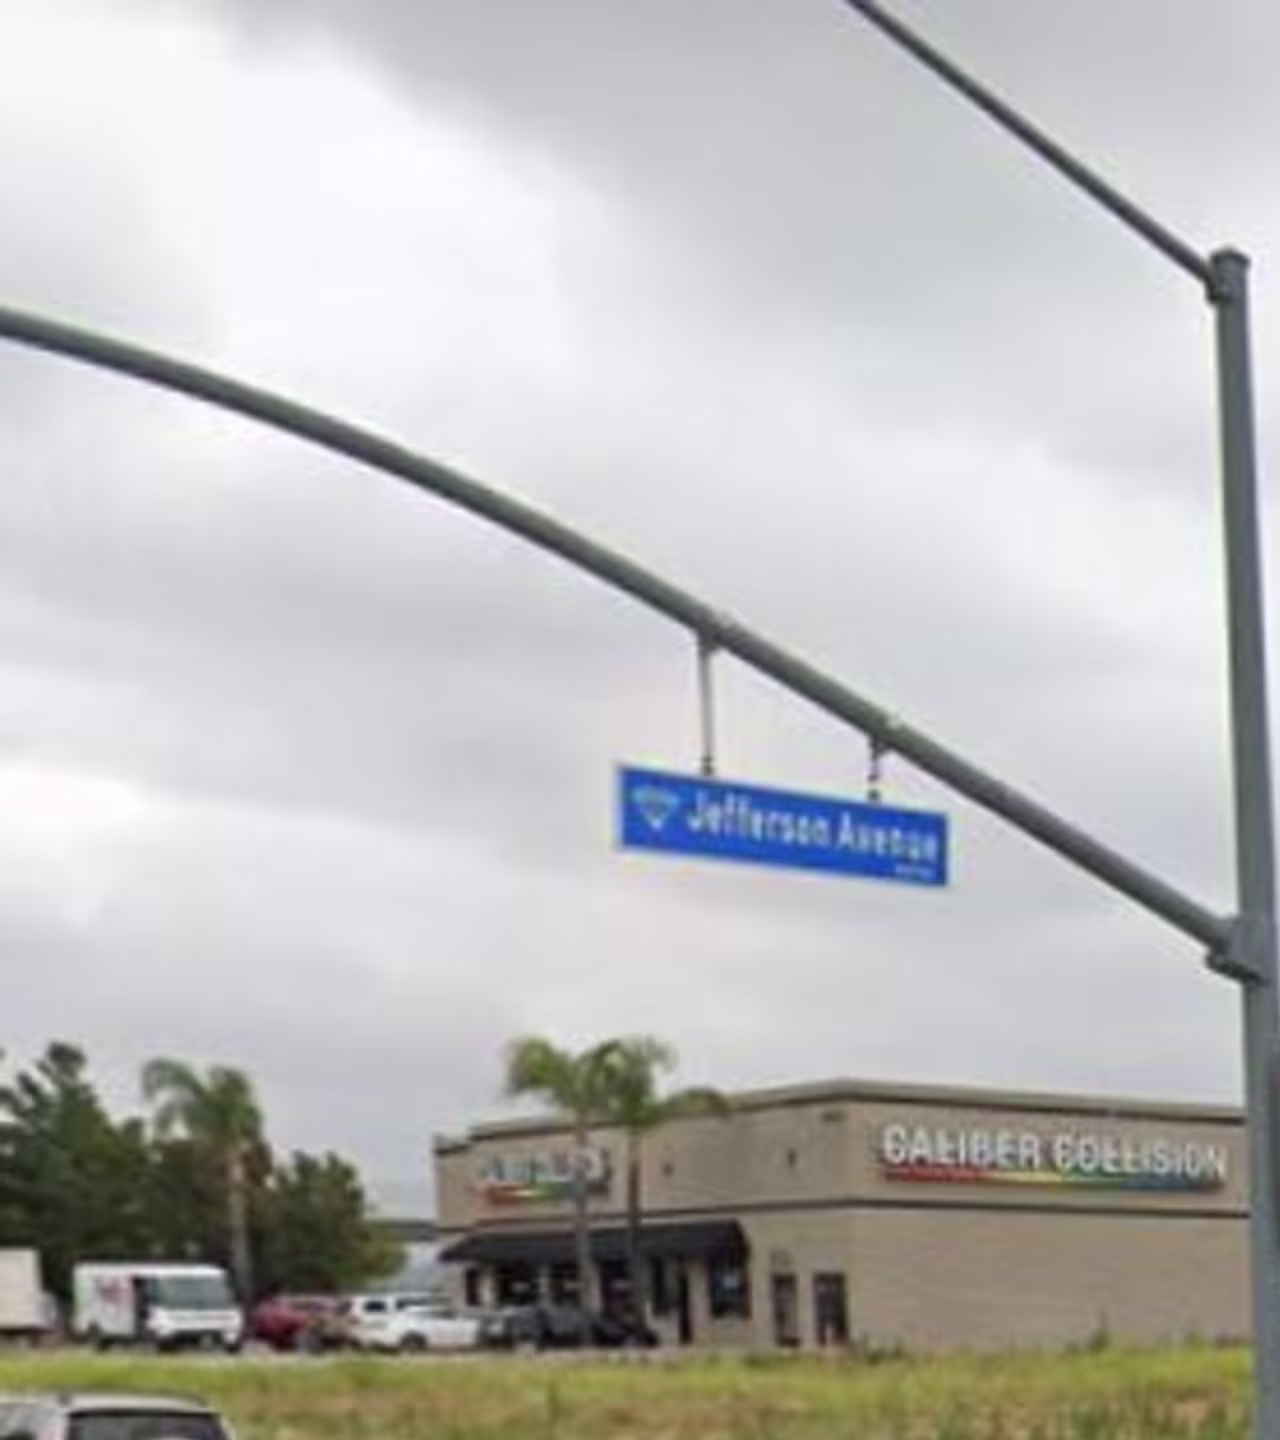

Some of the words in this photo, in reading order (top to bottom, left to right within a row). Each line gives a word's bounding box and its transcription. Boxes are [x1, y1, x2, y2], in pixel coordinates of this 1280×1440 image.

[686, 788, 833, 848] Jefferson
[836, 810, 939, 863] Avenue
[882, 1124, 1043, 1170] CALIBER
[1052, 1134, 1229, 1180] COLLISION
